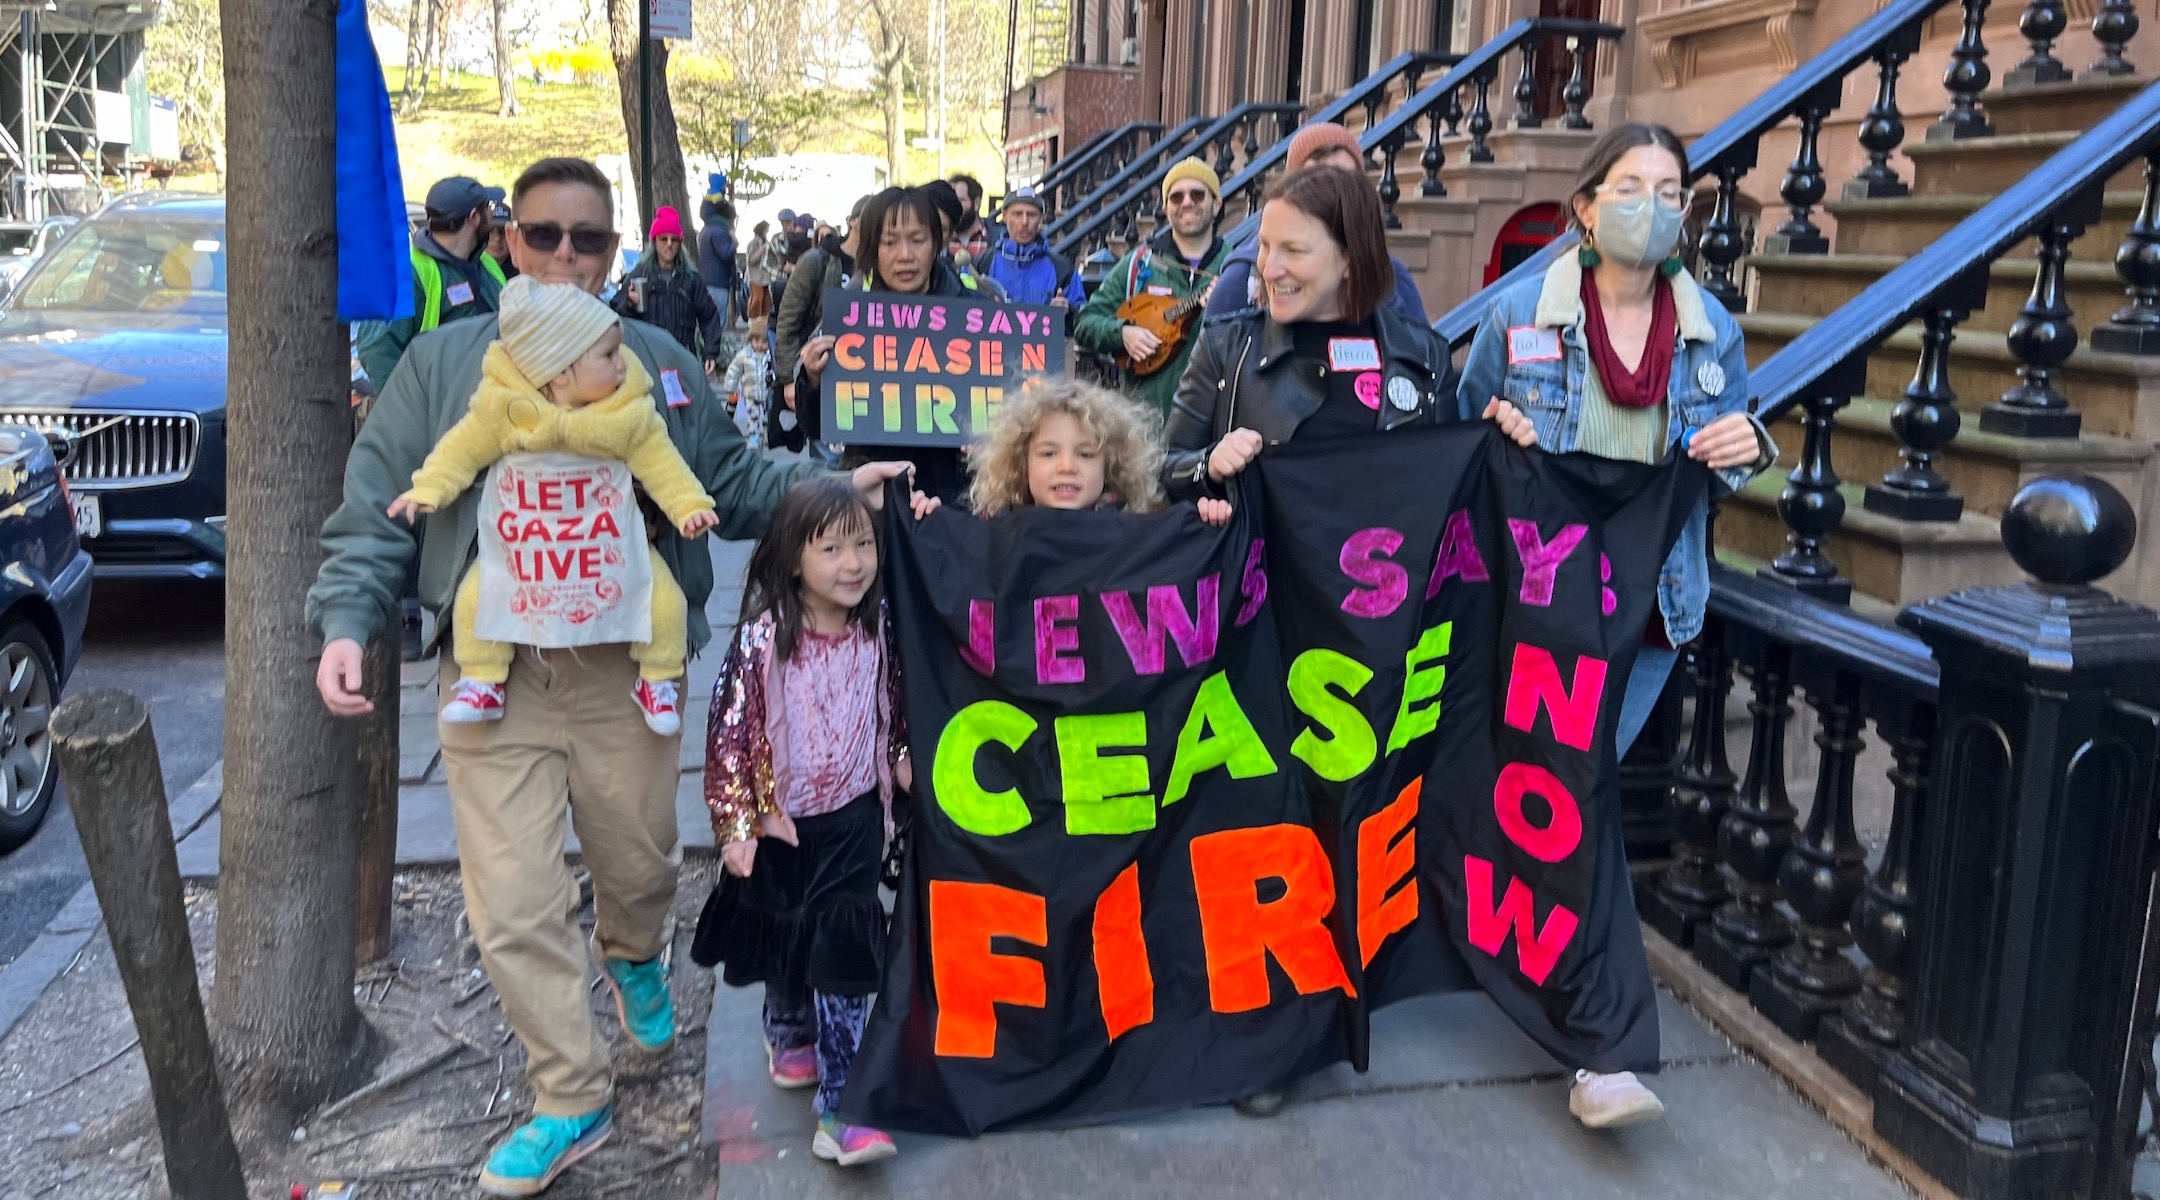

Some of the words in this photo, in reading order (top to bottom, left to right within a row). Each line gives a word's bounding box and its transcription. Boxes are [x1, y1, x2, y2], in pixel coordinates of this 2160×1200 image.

[842, 301, 947, 332] JEWS
[965, 307, 1051, 337] SAY:
[834, 332, 1004, 377] CEASE
[835, 381, 1004, 435] FIRE
[516, 477, 592, 512] LET
[497, 511, 621, 543] GAZA
[514, 547, 602, 582] LIVE
[958, 537, 1268, 684] JEWS
[1339, 508, 1617, 618] SAY:
[932, 621, 1453, 836] CEASE
[1465, 642, 1608, 986] NOW
[929, 775, 1423, 1058] FIRE
